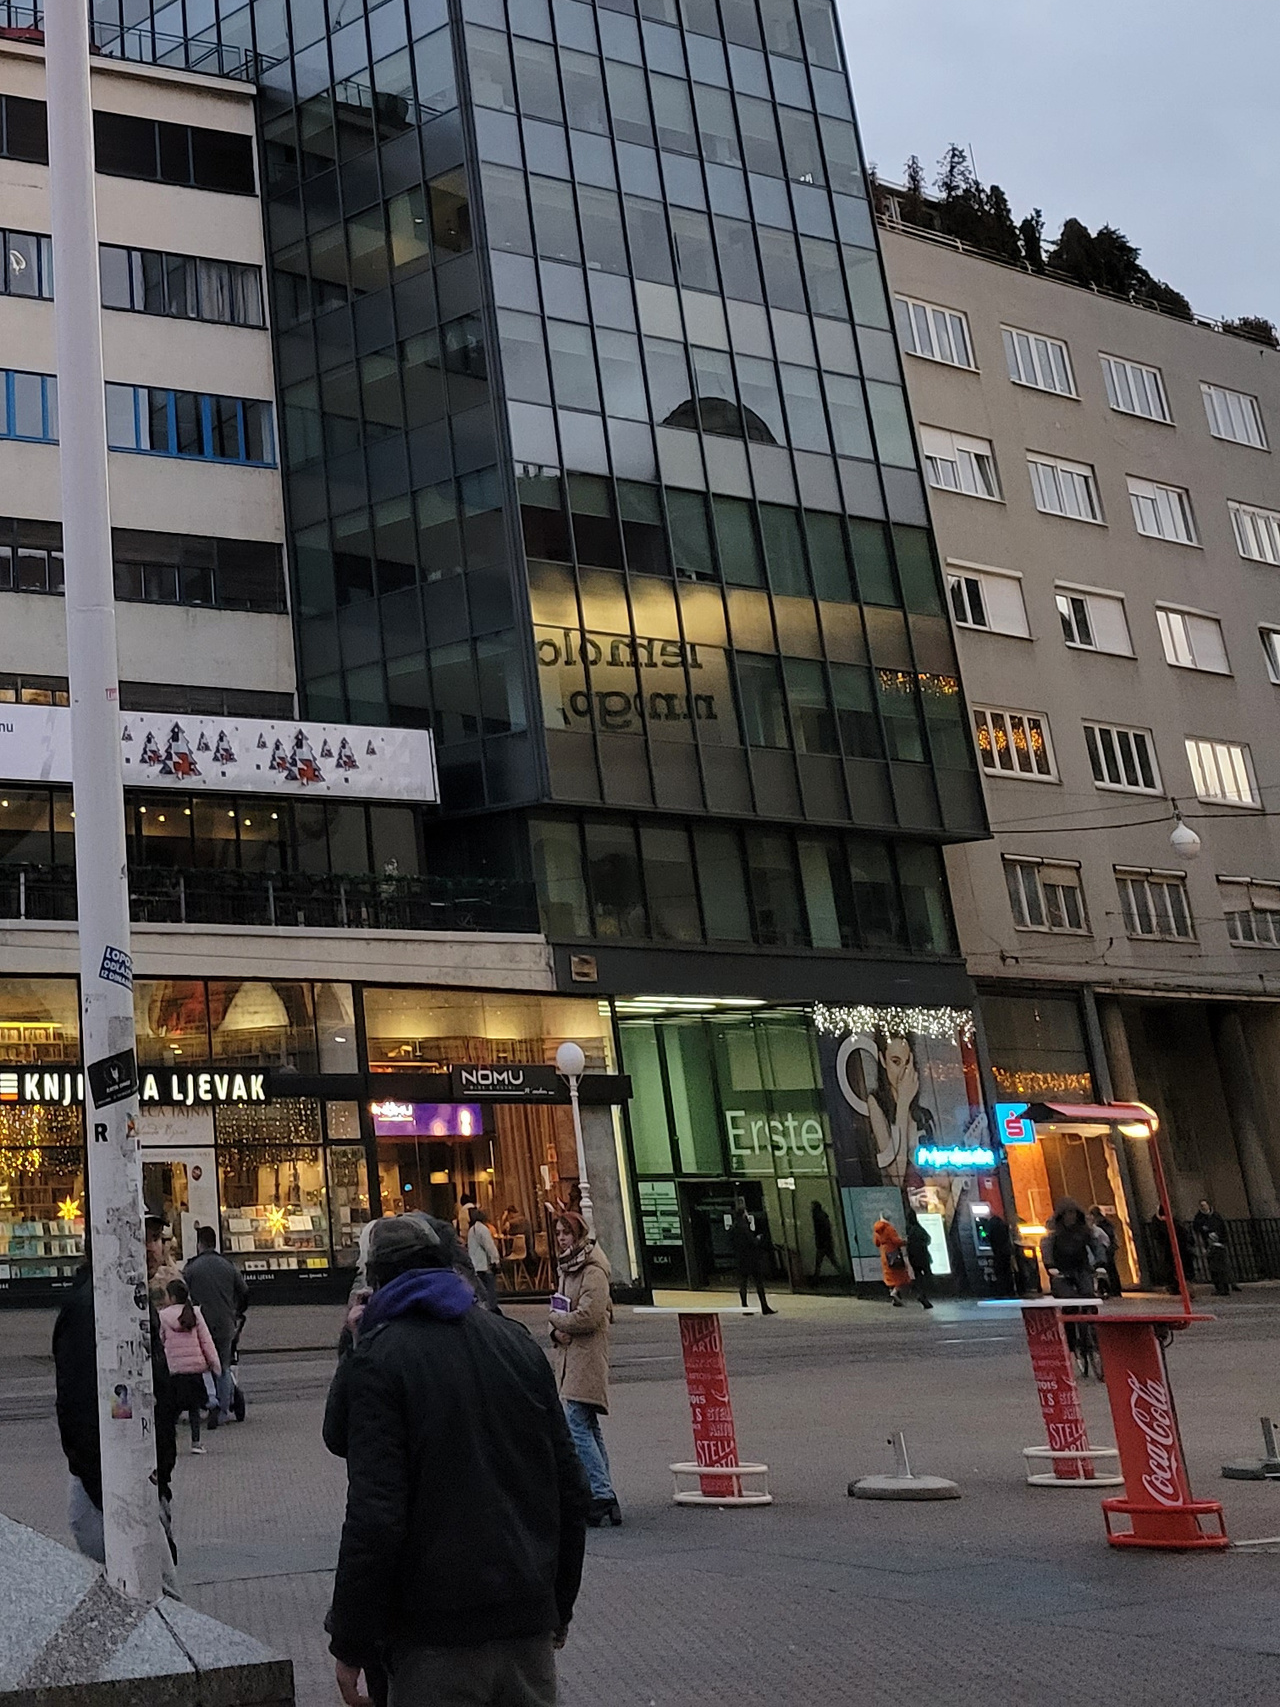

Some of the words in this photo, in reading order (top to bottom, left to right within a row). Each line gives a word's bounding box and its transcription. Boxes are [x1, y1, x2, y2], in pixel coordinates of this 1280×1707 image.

[24, 1073, 160, 1106] KNJIA
[171, 1073, 266, 1105] LJEVAK
[461, 1069, 524, 1085] NOMU
[725, 1109, 824, 1157] Erste
